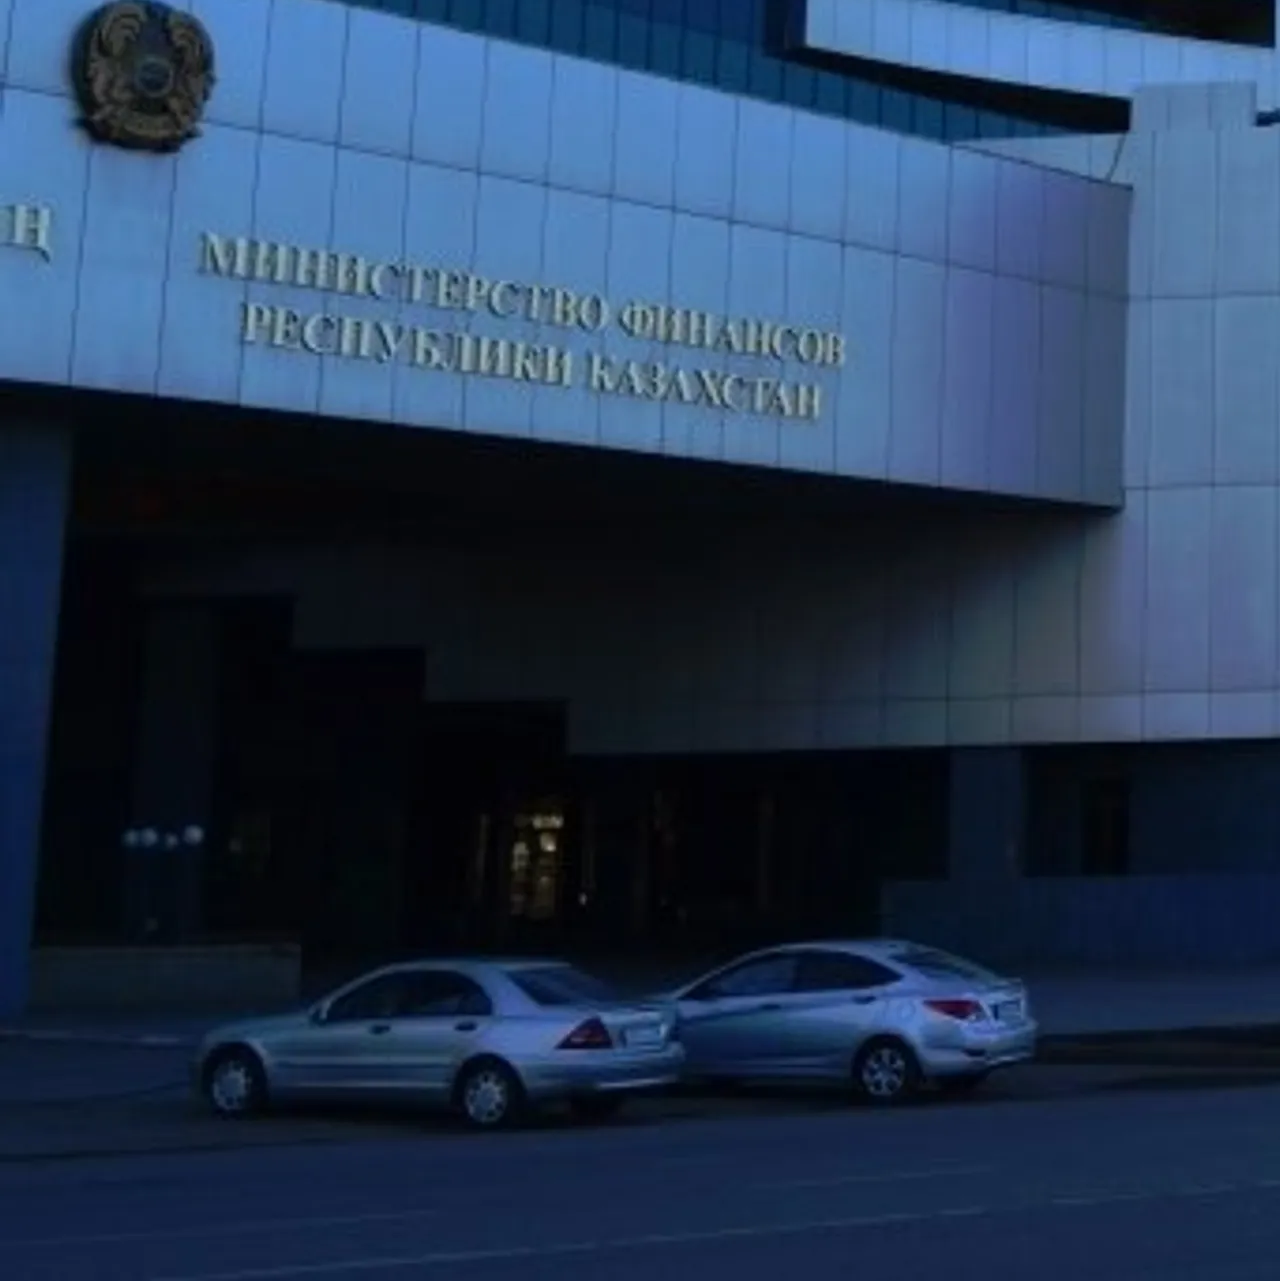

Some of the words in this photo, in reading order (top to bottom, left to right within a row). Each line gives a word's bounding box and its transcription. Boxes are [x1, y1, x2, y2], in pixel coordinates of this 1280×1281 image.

[199, 230, 609, 333] МИНИСТЕРСТВО
[618, 300, 846, 367] ФИНАНСОВ
[240, 302, 573, 389] РЕСПУБЛИКИ
[588, 352, 821, 420] КАЗАХСТАН
